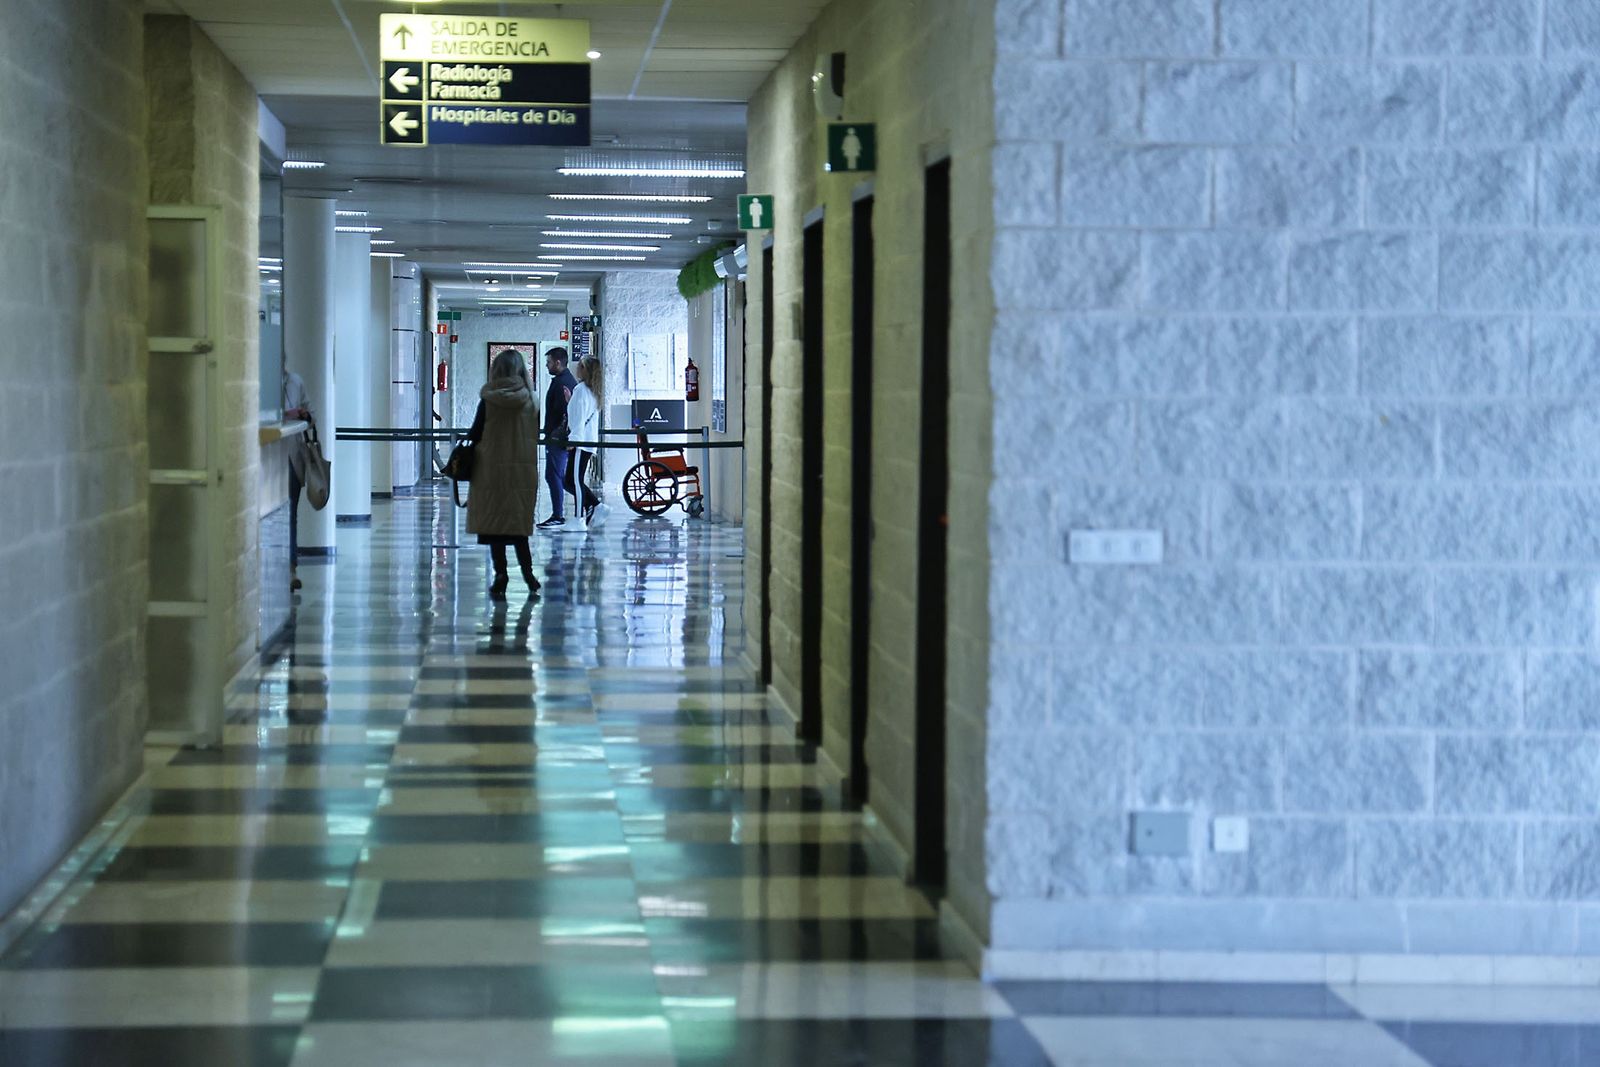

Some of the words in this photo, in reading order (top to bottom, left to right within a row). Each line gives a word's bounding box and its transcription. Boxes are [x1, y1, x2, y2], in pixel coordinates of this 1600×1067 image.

[431, 20, 489, 36] SALIDA
[495, 21, 518, 37] DE
[431, 40, 549, 57] EMERGENCIA
[430, 63, 513, 86] Radiología
[431, 106, 519, 126] Hospitales
[522, 108, 545, 124] de
[547, 109, 577, 124] Día
